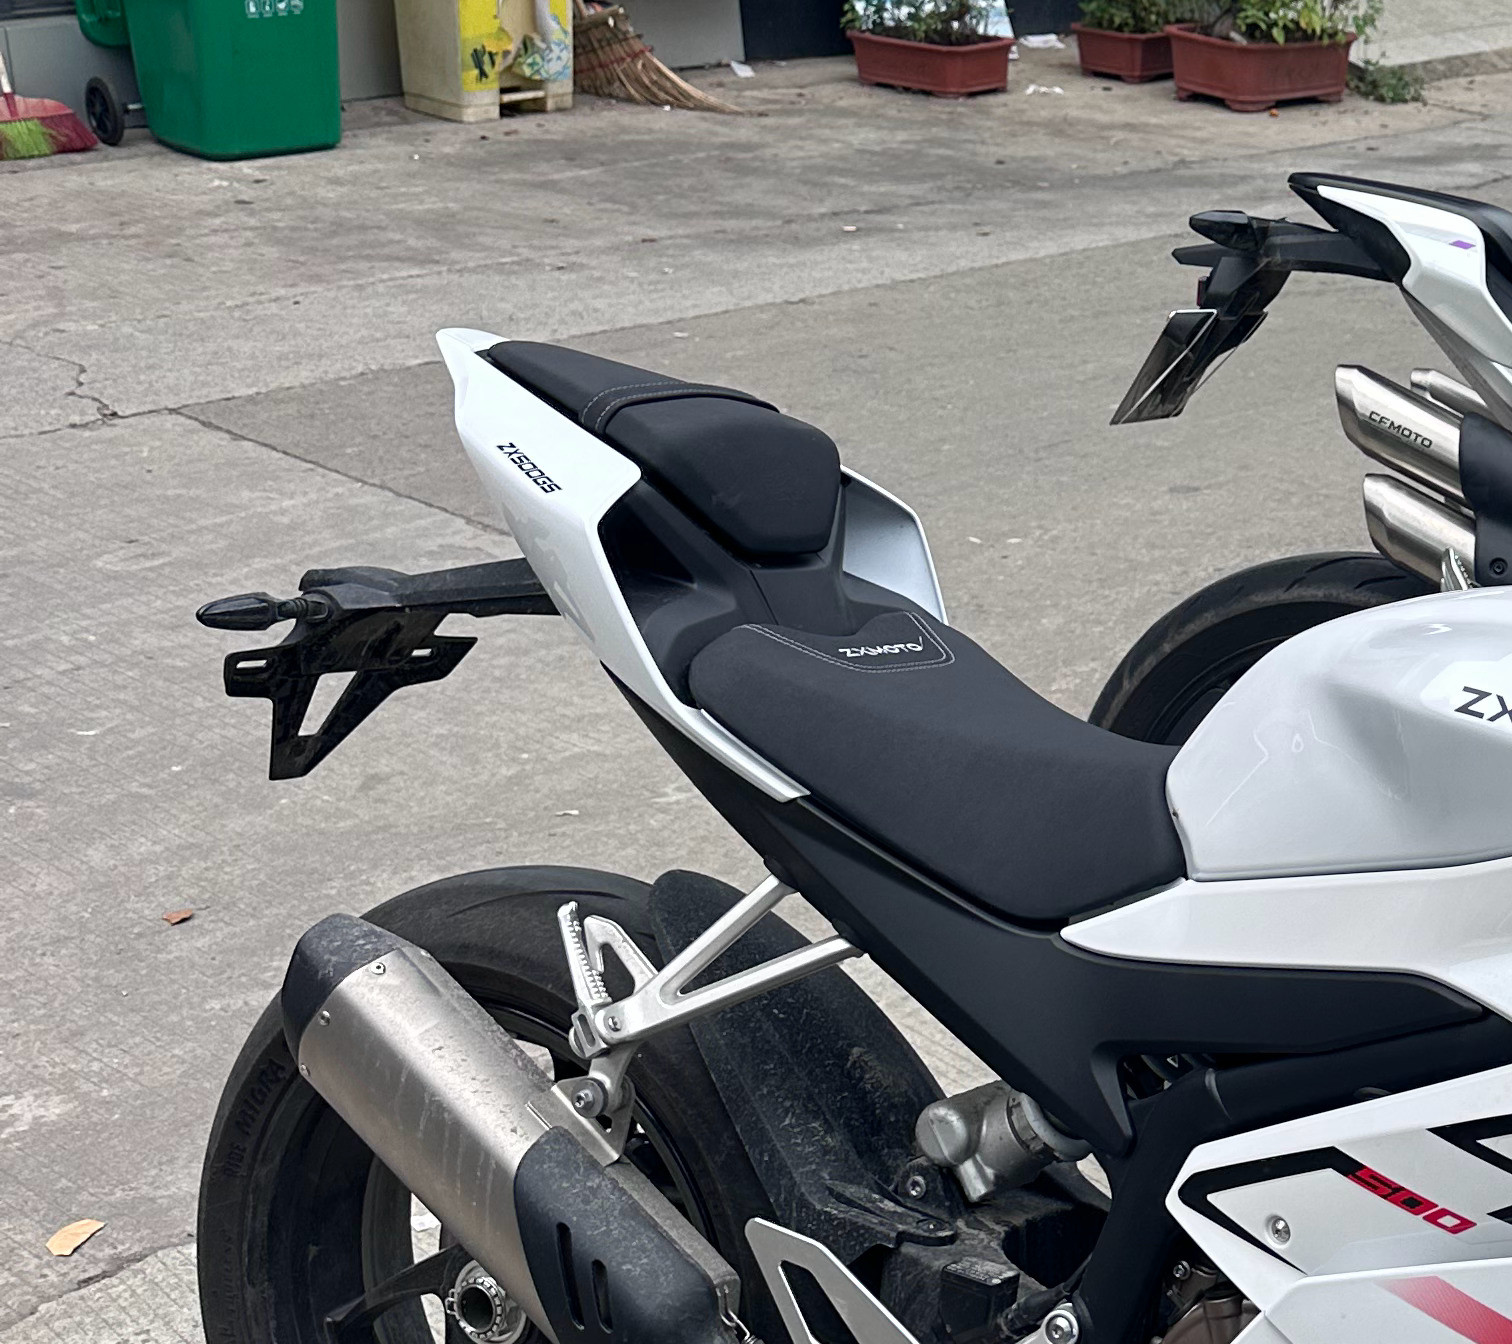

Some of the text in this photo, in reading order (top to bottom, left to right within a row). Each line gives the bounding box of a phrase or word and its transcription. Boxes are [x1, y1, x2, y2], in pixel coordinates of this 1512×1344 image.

[1368, 410, 1433, 449] CFMOTO
[838, 635, 924, 658] ZXMOTO
[234, 1057, 287, 1138] MIGRA
[1346, 1165, 1478, 1235] 500
